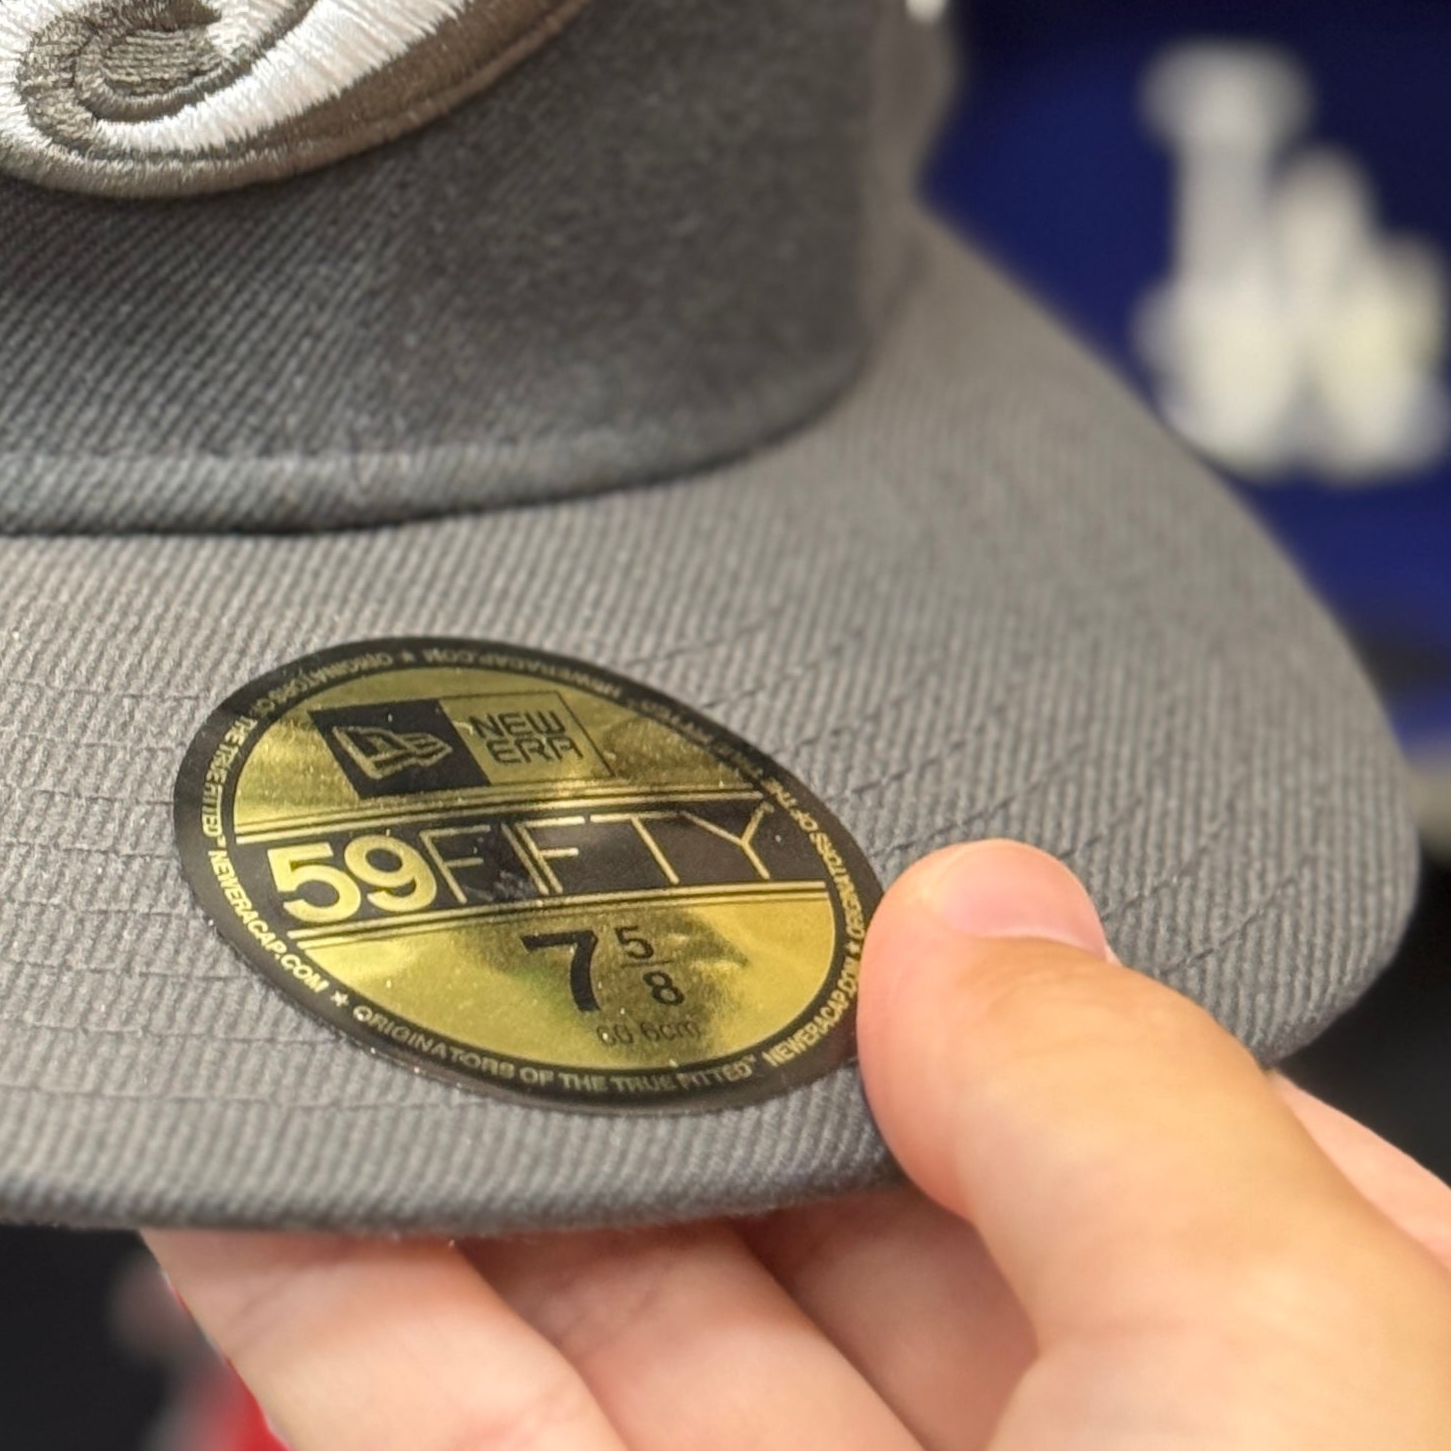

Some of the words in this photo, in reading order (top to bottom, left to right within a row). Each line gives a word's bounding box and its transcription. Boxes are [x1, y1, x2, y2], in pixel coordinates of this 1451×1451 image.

[224, 716, 258, 748] THE
[469, 711, 566, 738] NEW
[486, 735, 584, 764] ERA
[267, 803, 774, 924] 59FIFTY
[208, 850, 330, 994] NEWERACAP.COM
[520, 930, 601, 1012] 7
[352, 1005, 515, 1079] ORIGINATORS
[519, 1066, 554, 1086] OF
[556, 1071, 608, 1092] THE
[610, 1072, 677, 1093] TRUE
[596, 1020, 701, 1045] 606cm
